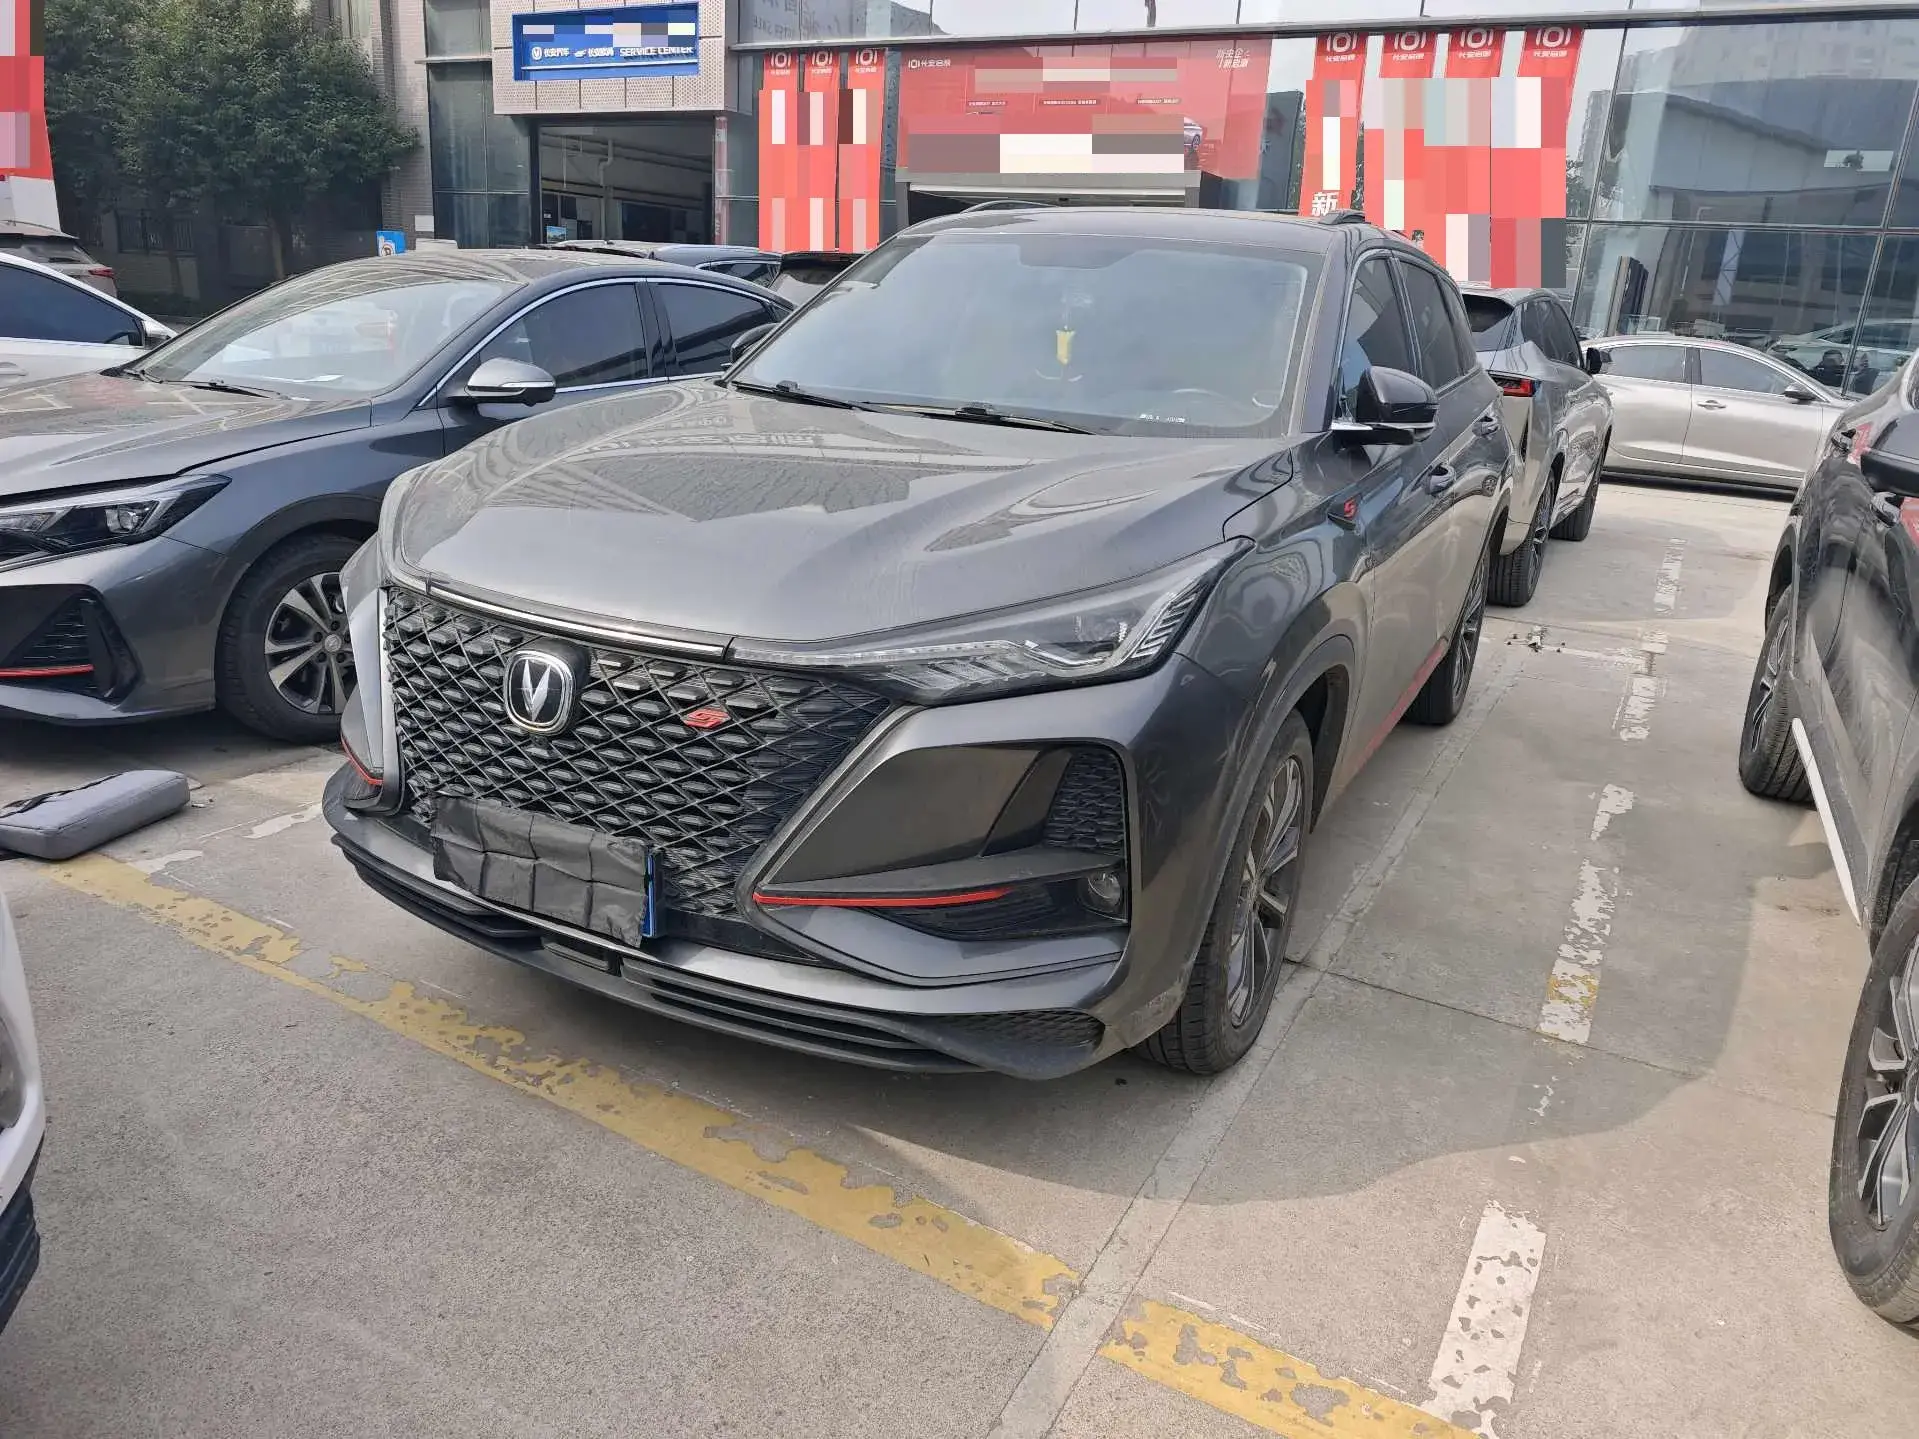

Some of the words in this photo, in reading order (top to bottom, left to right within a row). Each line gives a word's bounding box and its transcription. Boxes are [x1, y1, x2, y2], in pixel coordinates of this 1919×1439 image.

[619, 46, 657, 57] SERVICE
[657, 45, 694, 56] CENTER
[1311, 191, 1339, 217] 新
